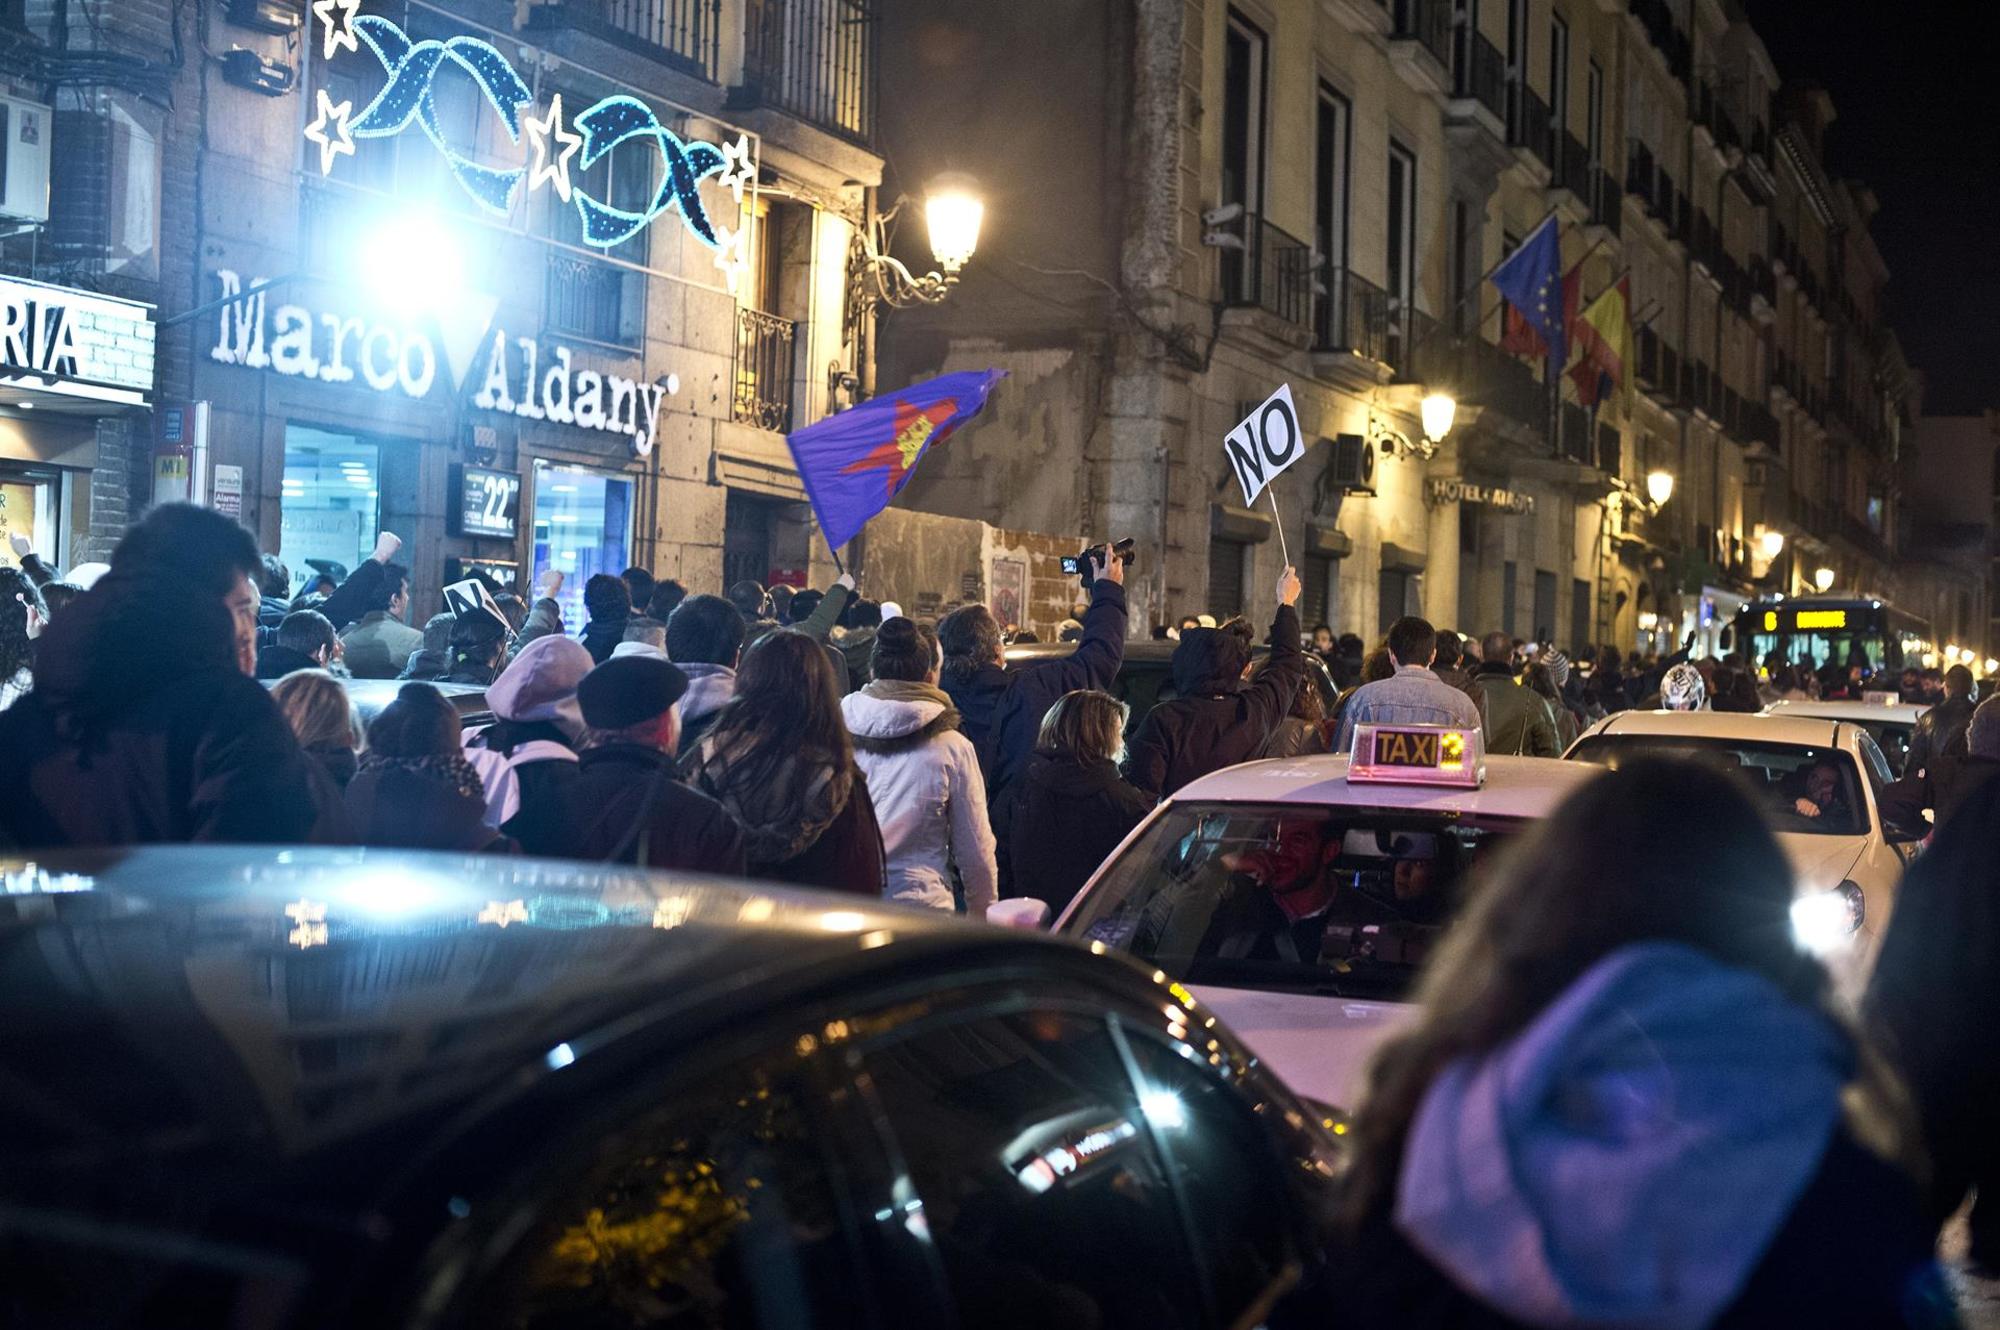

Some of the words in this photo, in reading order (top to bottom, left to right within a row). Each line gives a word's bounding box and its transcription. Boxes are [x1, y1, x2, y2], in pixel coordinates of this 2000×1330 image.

[211, 269, 435, 398] Marco
[475, 329, 667, 456] Aldany
[1227, 398, 1296, 500] NO
[1434, 480, 1482, 502] HOTEL
[1377, 733, 1437, 765] TAXI
